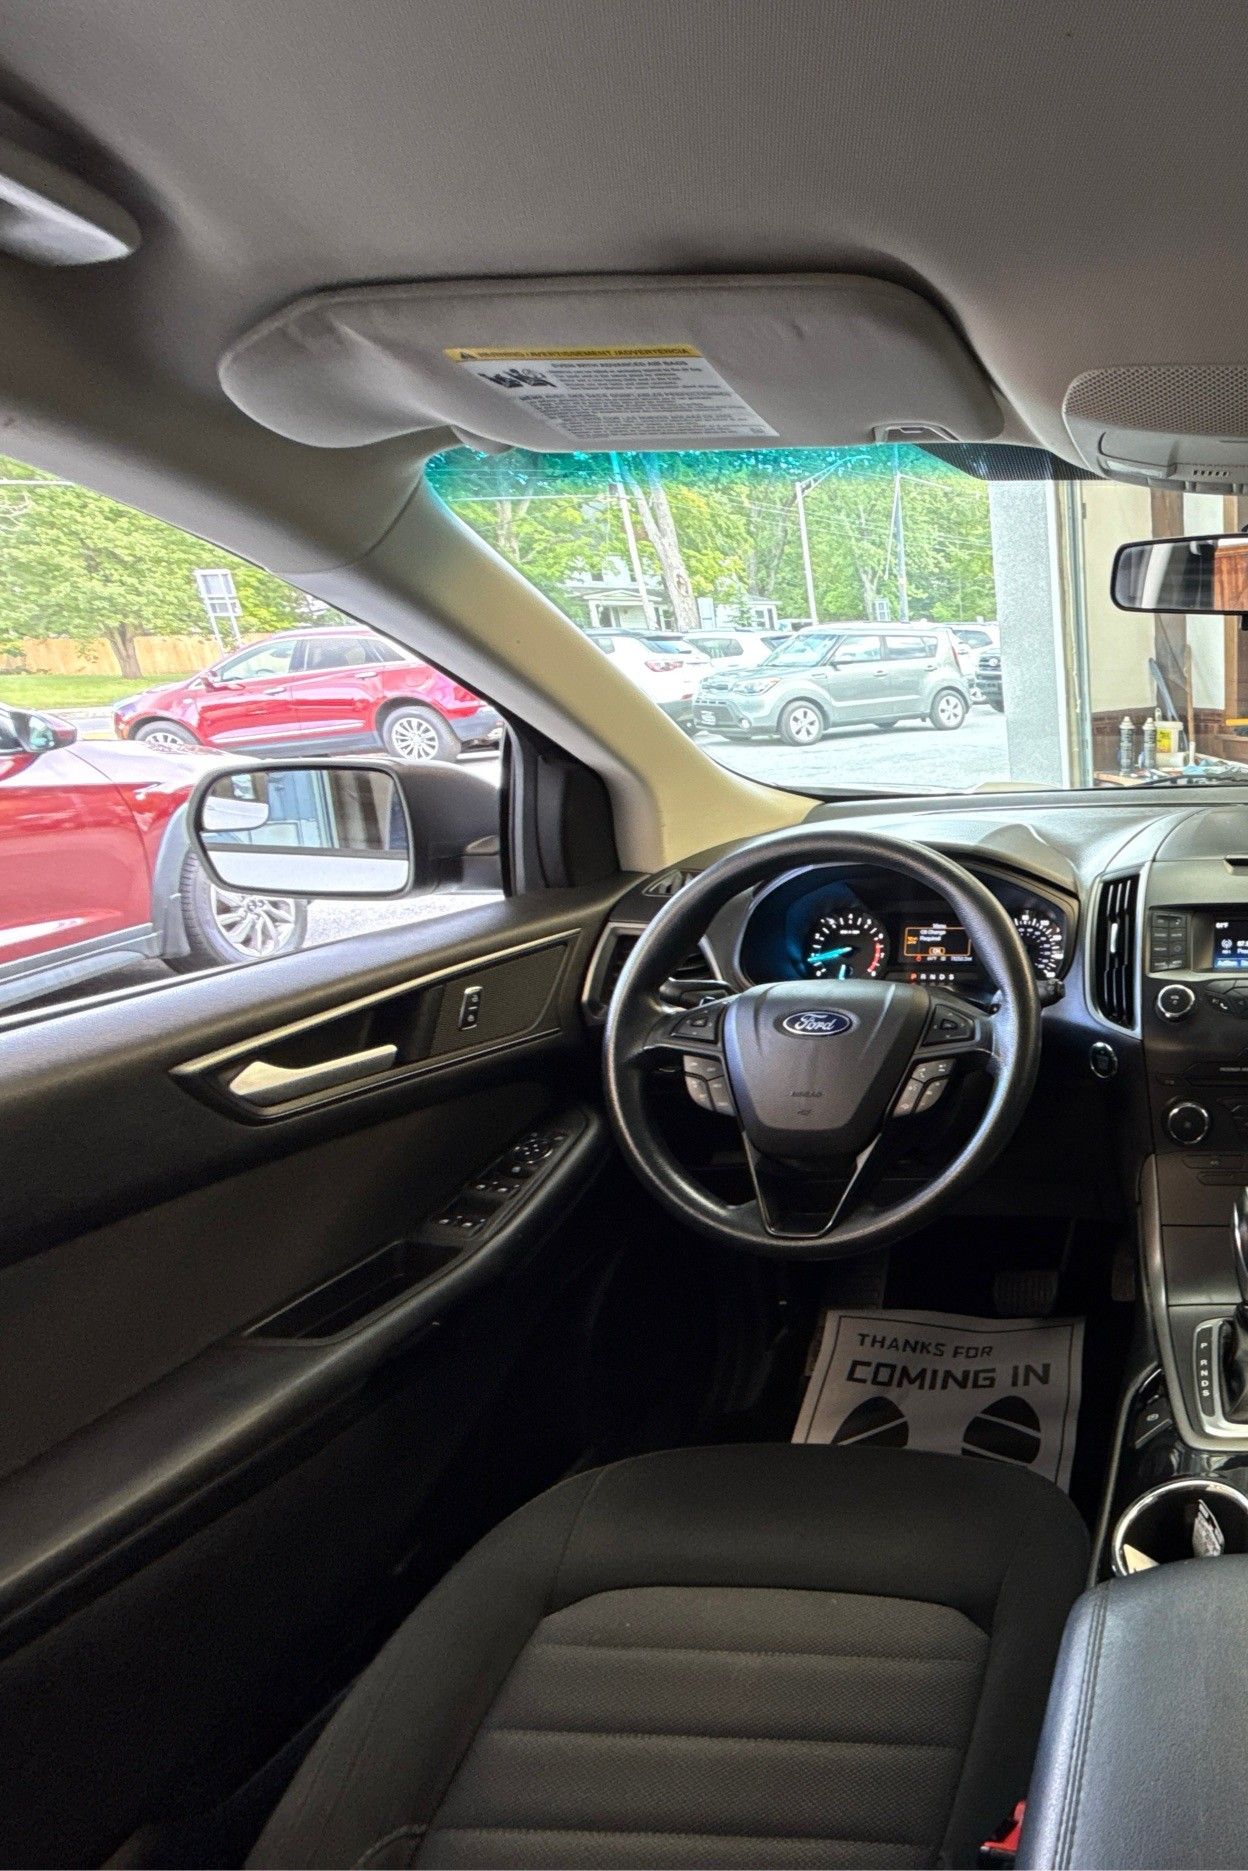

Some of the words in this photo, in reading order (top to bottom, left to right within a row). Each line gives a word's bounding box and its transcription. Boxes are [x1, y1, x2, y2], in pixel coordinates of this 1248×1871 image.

[795, 1013, 837, 1031] Ford
[858, 1333, 946, 1357] THANKS
[952, 1345, 994, 1359] FOR
[846, 1360, 996, 1390] COMING
[1011, 1363, 1051, 1387] IN
[1202, 1389, 1210, 1397] S
